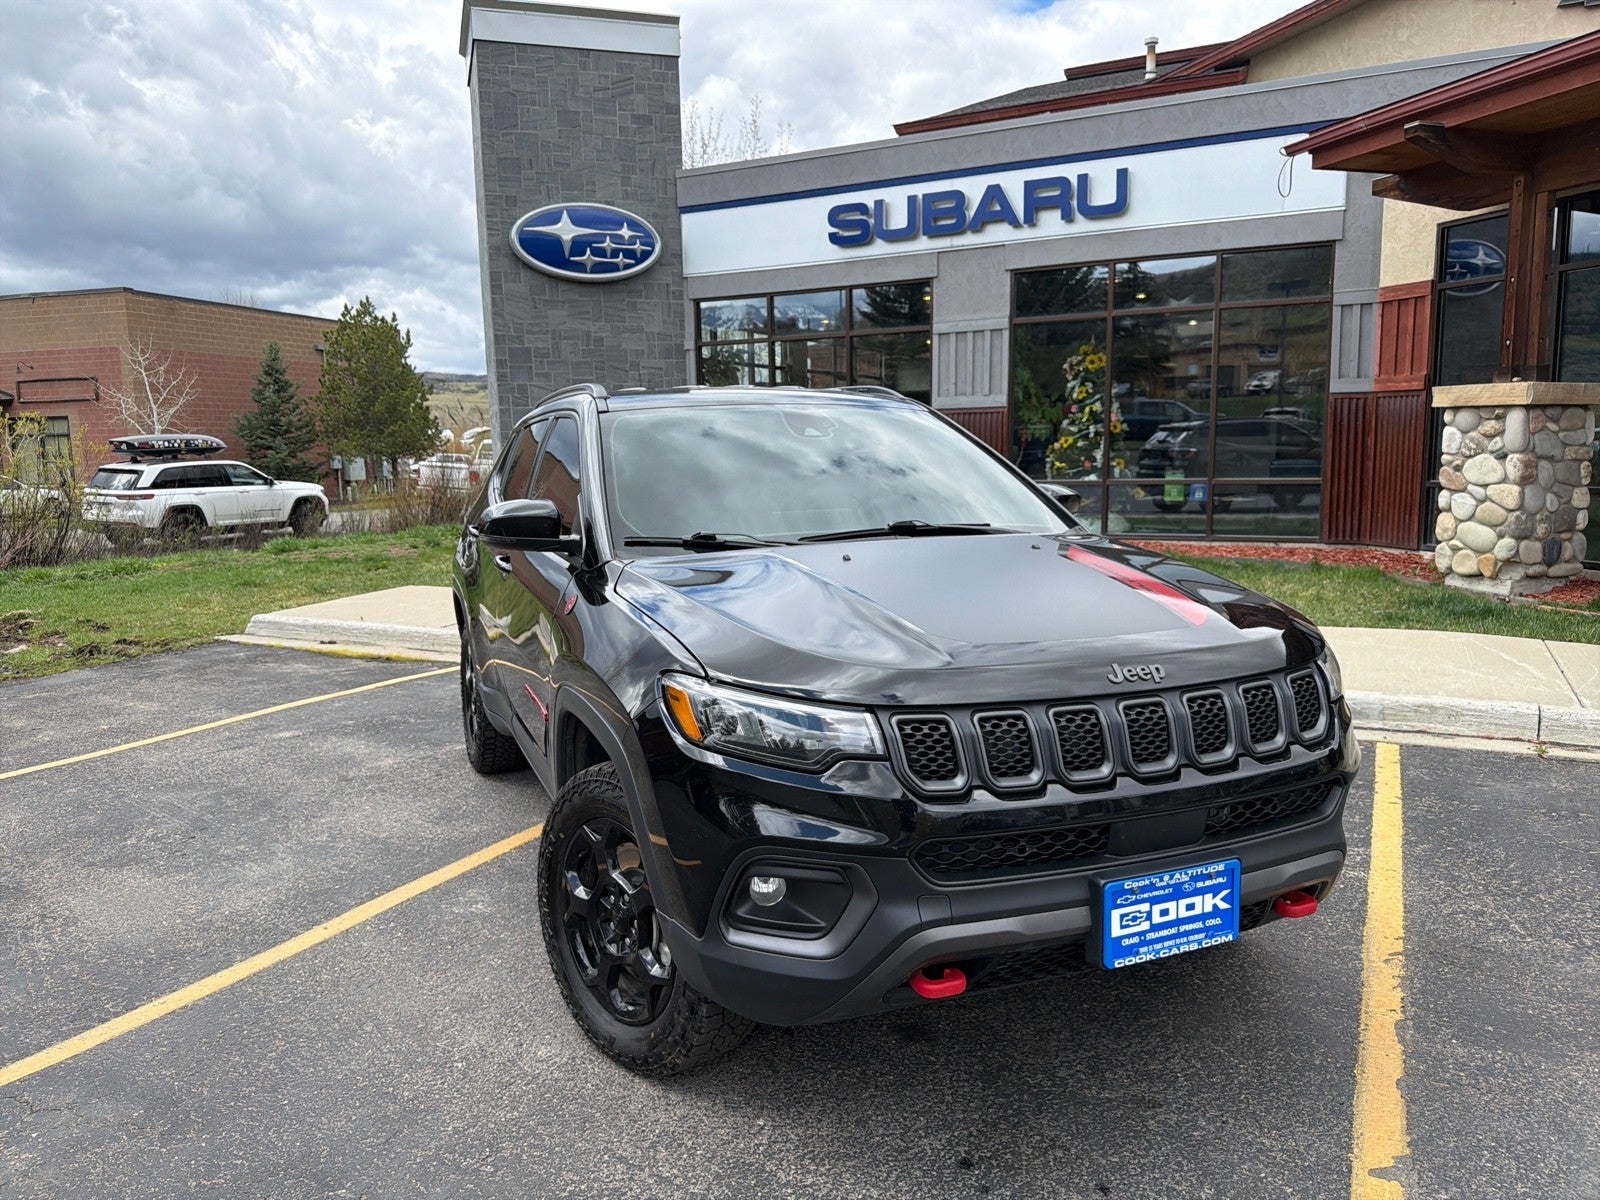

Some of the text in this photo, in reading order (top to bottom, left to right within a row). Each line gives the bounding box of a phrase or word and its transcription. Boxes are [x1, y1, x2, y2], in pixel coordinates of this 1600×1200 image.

[827, 167, 1131, 248] SUBARU
[1107, 663, 1166, 684] Jeep
[1173, 864, 1226, 880] ALTITUDE
[1196, 877, 1226, 888] SUBARU
[1137, 888, 1173, 900] CHEVROLET
[1111, 888, 1232, 938] COOK
[1121, 936, 1140, 946] CRAIG
[1146, 927, 1178, 940] STEAMBOAT
[1205, 918, 1222, 926] COLO.
